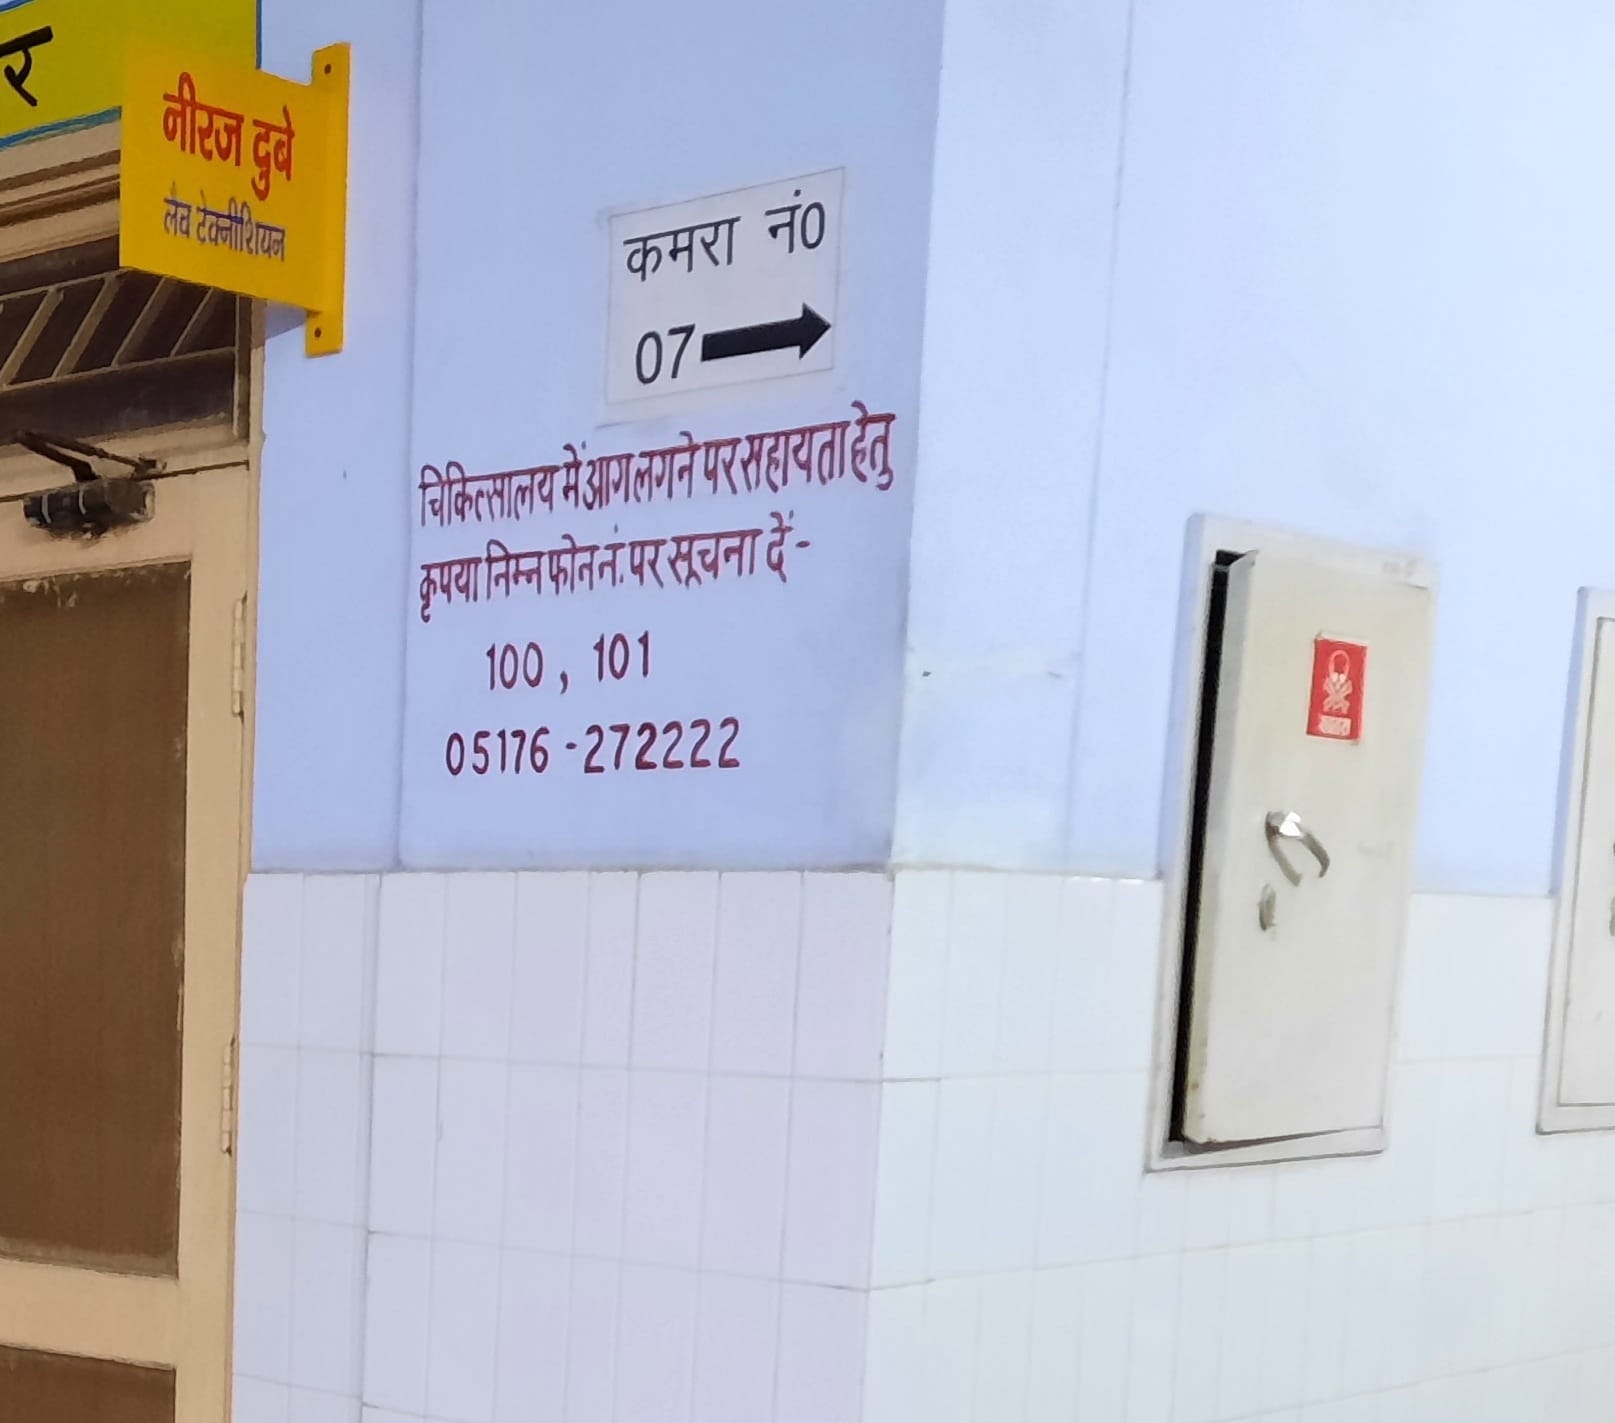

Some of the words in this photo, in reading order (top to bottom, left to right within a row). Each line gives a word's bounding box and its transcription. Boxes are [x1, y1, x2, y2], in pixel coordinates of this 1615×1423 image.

[163, 72, 244, 166] नीरज
[251, 105, 295, 200] दुबे
[623, 216, 741, 282] कमरा
[636, 324, 696, 385] 07
[418, 460, 561, 527] चिकित्सालय
[563, 440, 586, 508] में
[583, 452, 635, 511] आग
[634, 430, 702, 503] लगने
[702, 437, 742, 496] पर
[741, 420, 851, 494] सहायता
[851, 400, 896, 491] हेतु
[420, 557, 483, 623] कृपया
[485, 539, 546, 600] निम्न
[547, 534, 601, 595] फोन
[629, 539, 668, 589] पर
[667, 528, 764, 589] सूचना
[593, 630, 650, 681] 101
